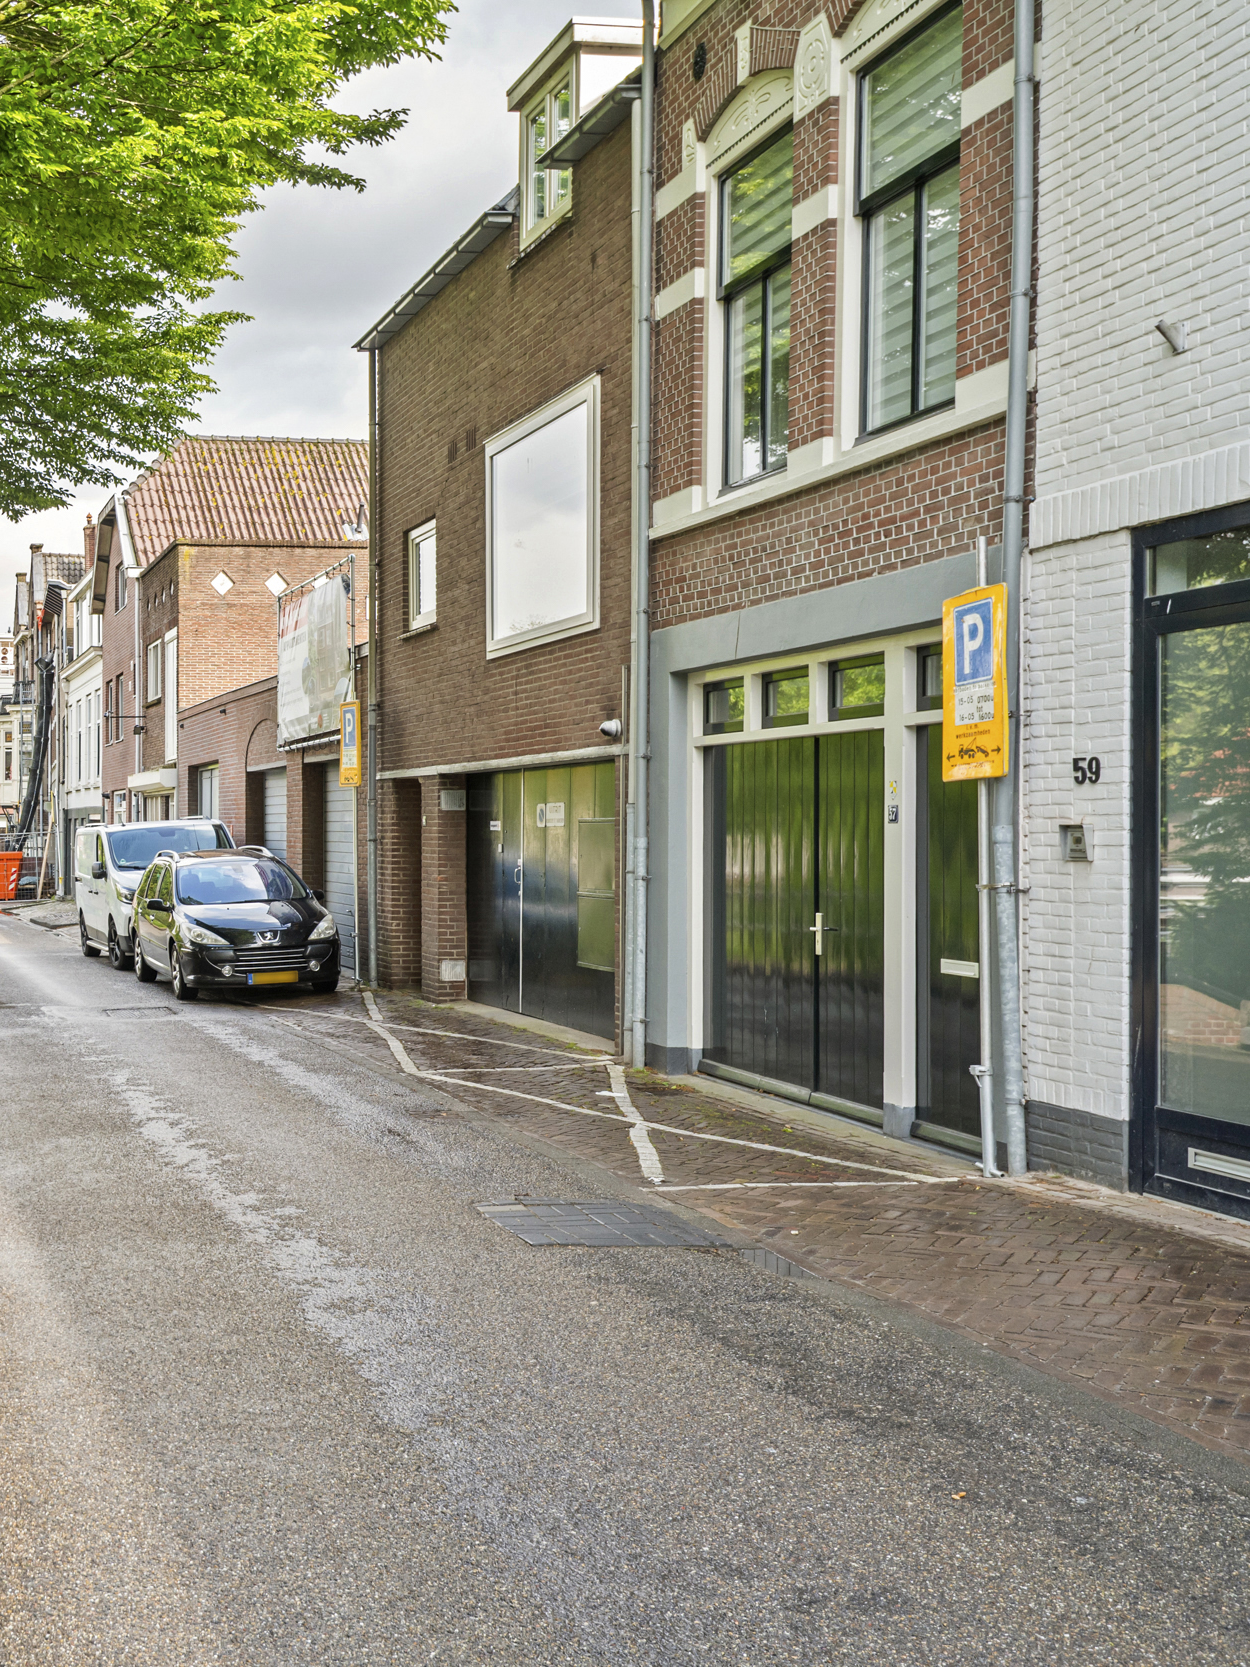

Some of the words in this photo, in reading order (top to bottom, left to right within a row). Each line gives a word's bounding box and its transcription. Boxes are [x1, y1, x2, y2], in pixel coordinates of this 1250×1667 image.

[963, 613, 984, 674] P
[345, 712, 353, 744] P
[956, 729, 991, 739] werkzaamheden
[1072, 756, 1101, 785] 59
